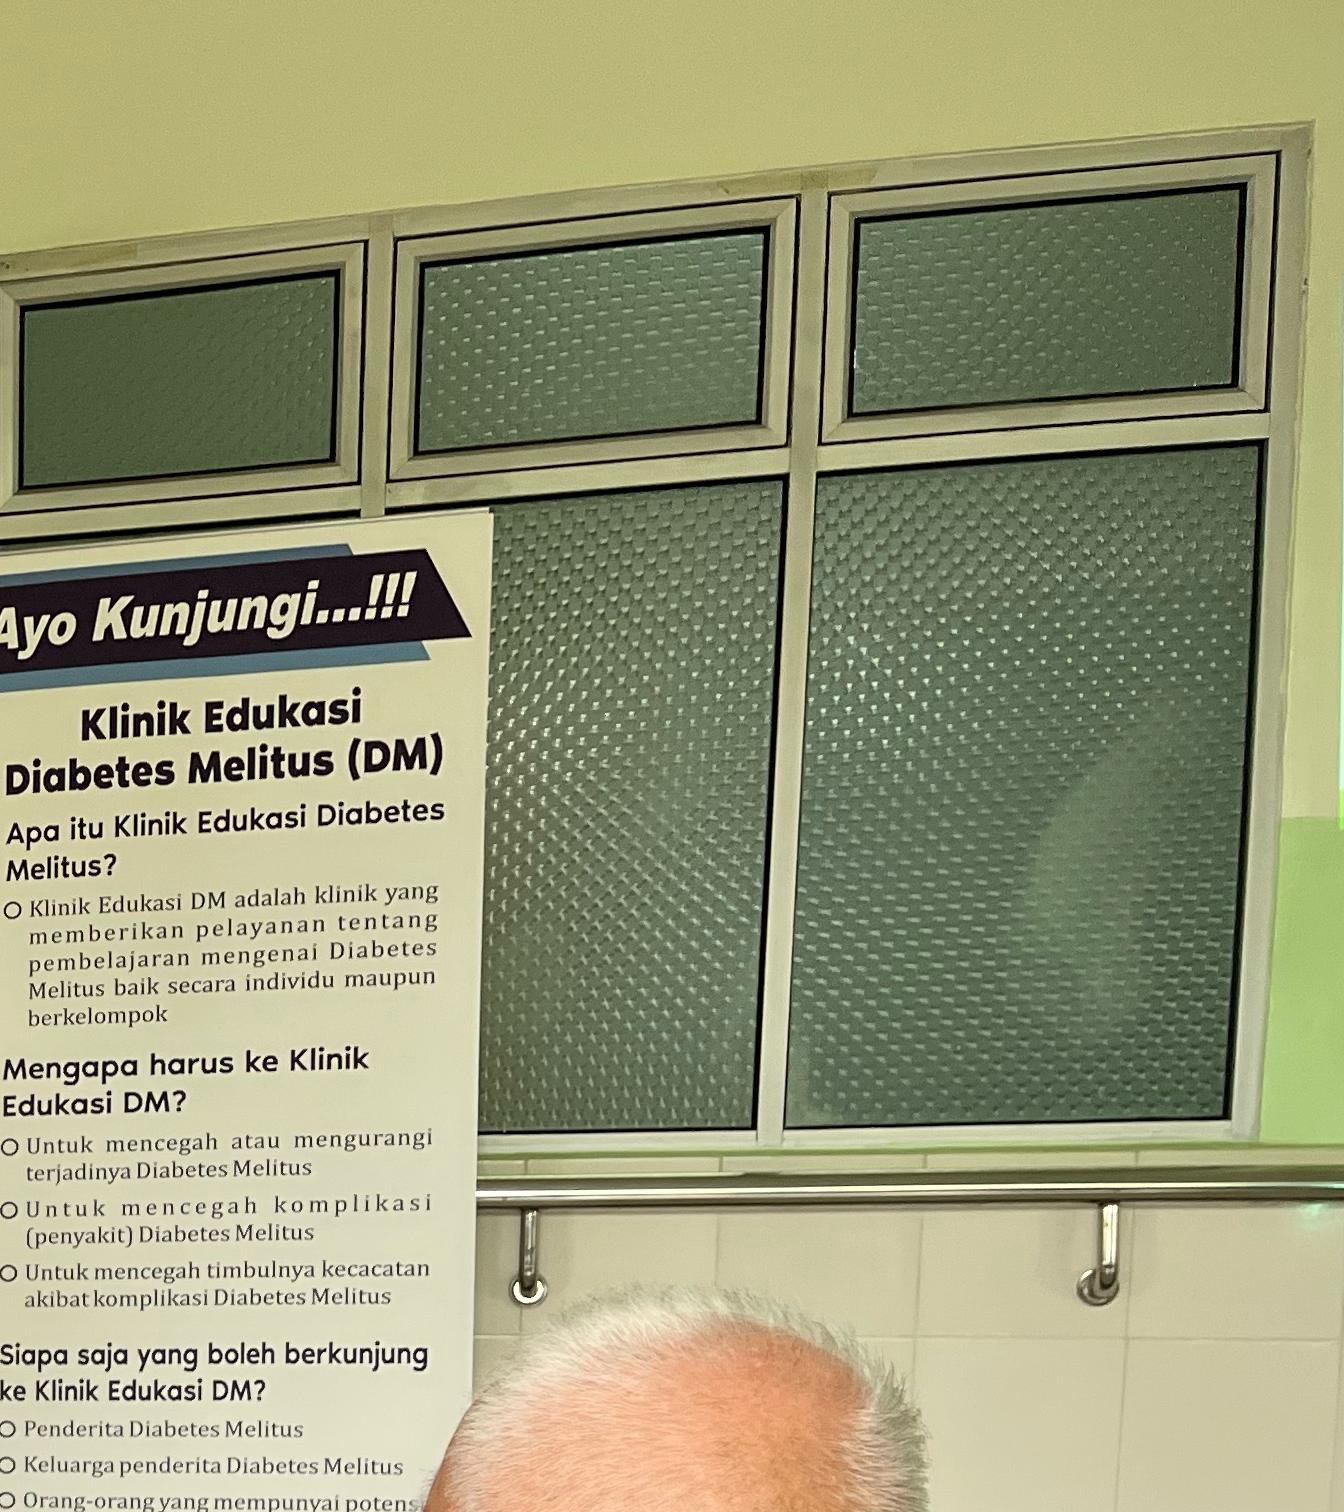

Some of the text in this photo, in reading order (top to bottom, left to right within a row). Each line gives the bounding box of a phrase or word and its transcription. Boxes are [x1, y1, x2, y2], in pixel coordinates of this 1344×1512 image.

[92, 570, 418, 645] Kunjungi...!!!
[82, 687, 361, 741] Klinik Edukasi
[6, 732, 442, 795] Diabetes Melitus (DM)
[6, 800, 444, 851] Apa itu Klinik Edukasi Diabetes
[6, 854, 116, 881] Melitus?
[31, 884, 438, 917] Klinik Edukasi DM adalah klinik yang
[30, 914, 437, 944] memberikan pelayanan tentang
[29, 940, 436, 977] pembelajaran mengenai Diabetes
[29, 971, 435, 1000] Melitus baik secara individu maupun
[29, 1005, 167, 1028] berkelompok
[3, 1046, 368, 1085] Mengapa harus ke Klinik
[3, 1090, 186, 1117] Edukasi DM?
[28, 1128, 431, 1155] Untuk mencegah atau mengurangi
[27, 1159, 311, 1185] terjadinya Diabetes Melitus
[27, 1194, 430, 1219] Untuk mencegah komplikasi
[27, 1223, 314, 1249] (penyakit) Diabetes Melitus
[26, 1260, 429, 1284] Untuk mencegah timbulnya kecacatan
[25, 1287, 391, 1311] akibat komplikasi Diabetes Melitus
[0, 1341, 427, 1372] Siapa saja yang boleh berkunjung
[0, 1378, 265, 1401] ke Klinik Edukasi DM?
[25, 1420, 303, 1437] Penderita Diabetes Melitus
[25, 1456, 403, 1477] Keluarga penderita Diabetes Melitus
